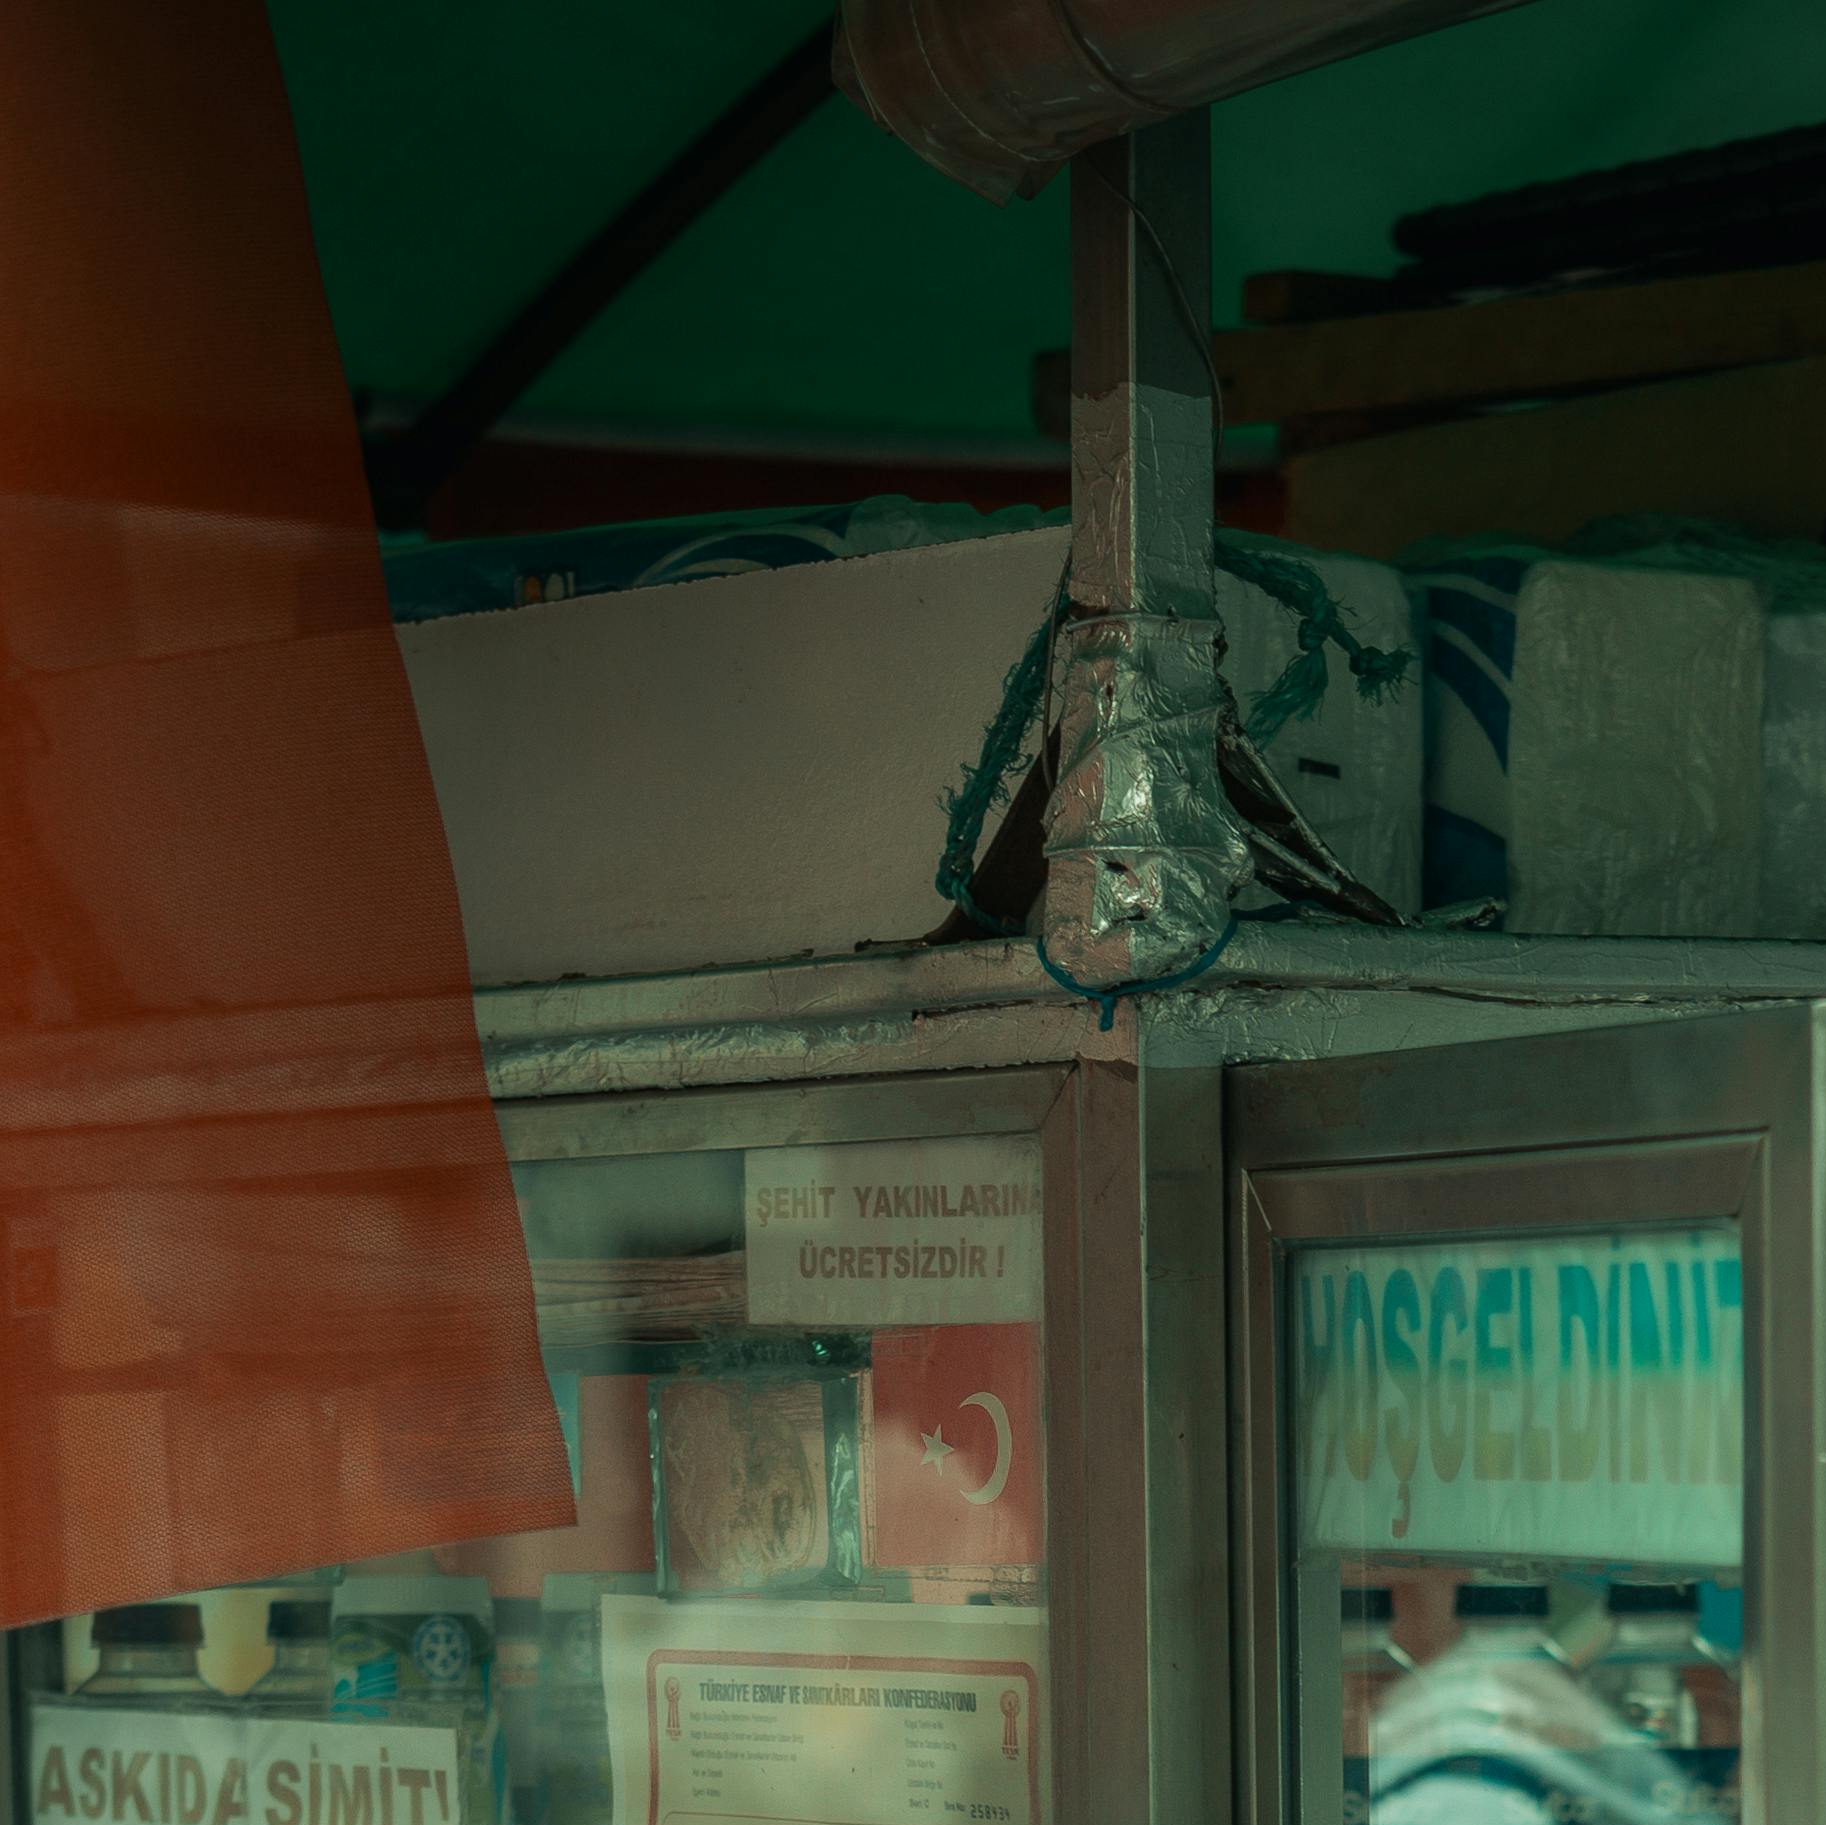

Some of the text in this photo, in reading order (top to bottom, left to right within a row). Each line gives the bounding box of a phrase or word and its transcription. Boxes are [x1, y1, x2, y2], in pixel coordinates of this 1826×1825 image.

[756, 1179, 835, 1228] ŞEHİT
[800, 1238, 987, 1279] ÜCRETSİZDİR
[699, 1679, 749, 1703] TÜRKİYE
[752, 1683, 786, 1704] ESNAF
[883, 1688, 977, 1713] KONFEDERASYONU
